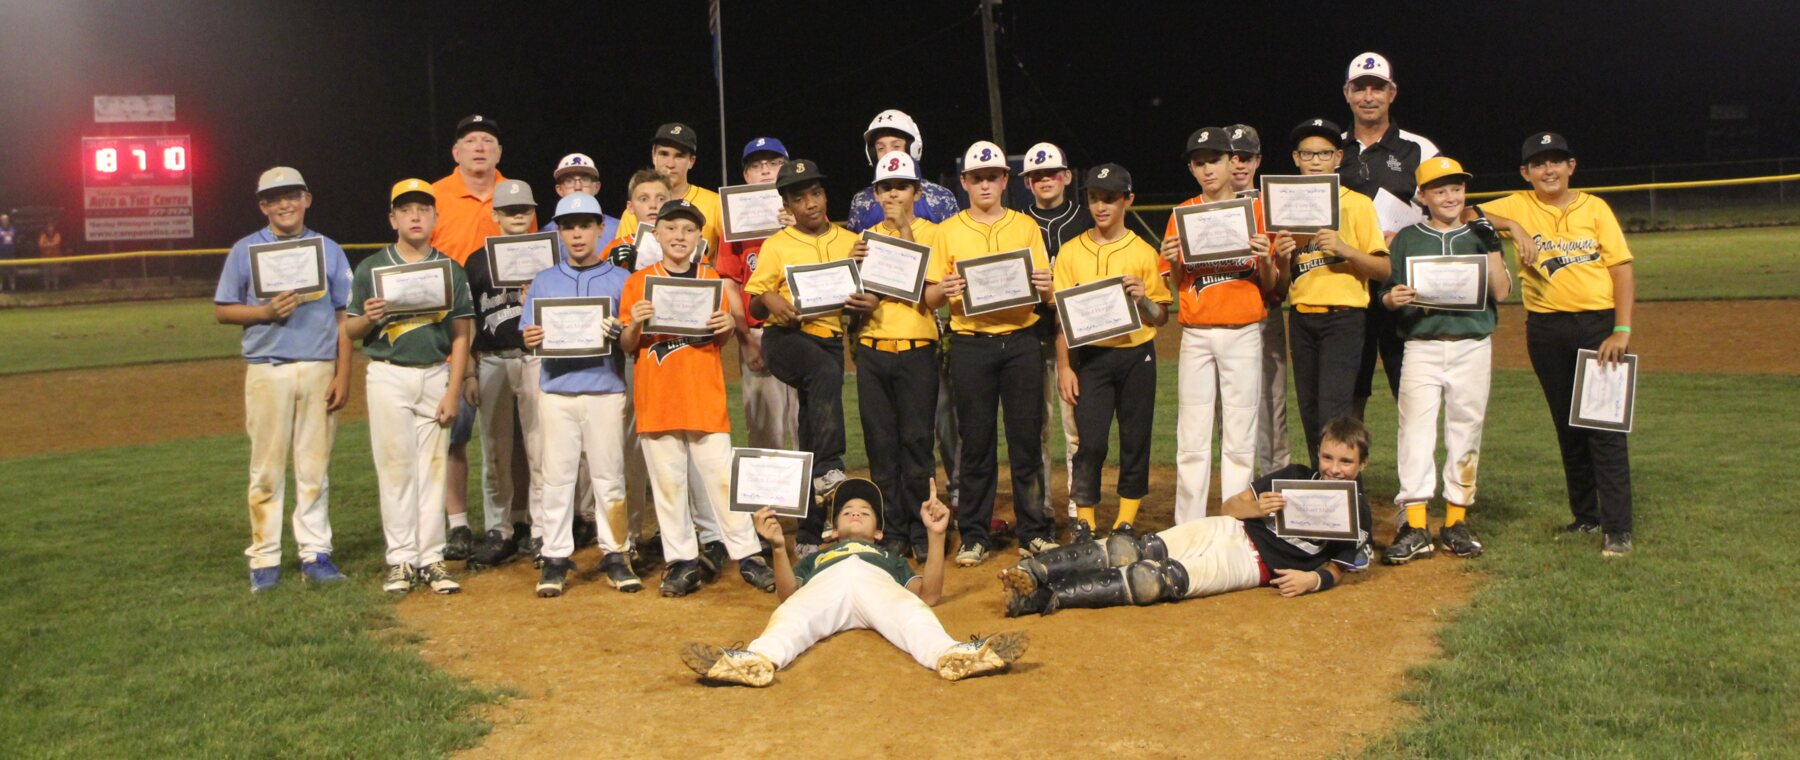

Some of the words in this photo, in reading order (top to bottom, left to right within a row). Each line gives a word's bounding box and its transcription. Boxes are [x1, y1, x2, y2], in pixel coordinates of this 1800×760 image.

[1363, 58, 1376, 70] B
[671, 126, 682, 135] B
[1232, 129, 1242, 139] B
[1198, 132, 1209, 142] B
[1541, 134, 1551, 144] B
[756, 138, 765, 147] B
[132, 149, 146, 170] 7
[980, 149, 992, 162] B
[1034, 150, 1047, 164] B
[796, 163, 805, 173] B
[888, 158, 900, 172] B
[1098, 169, 1109, 179] B
[511, 184, 519, 194] B
